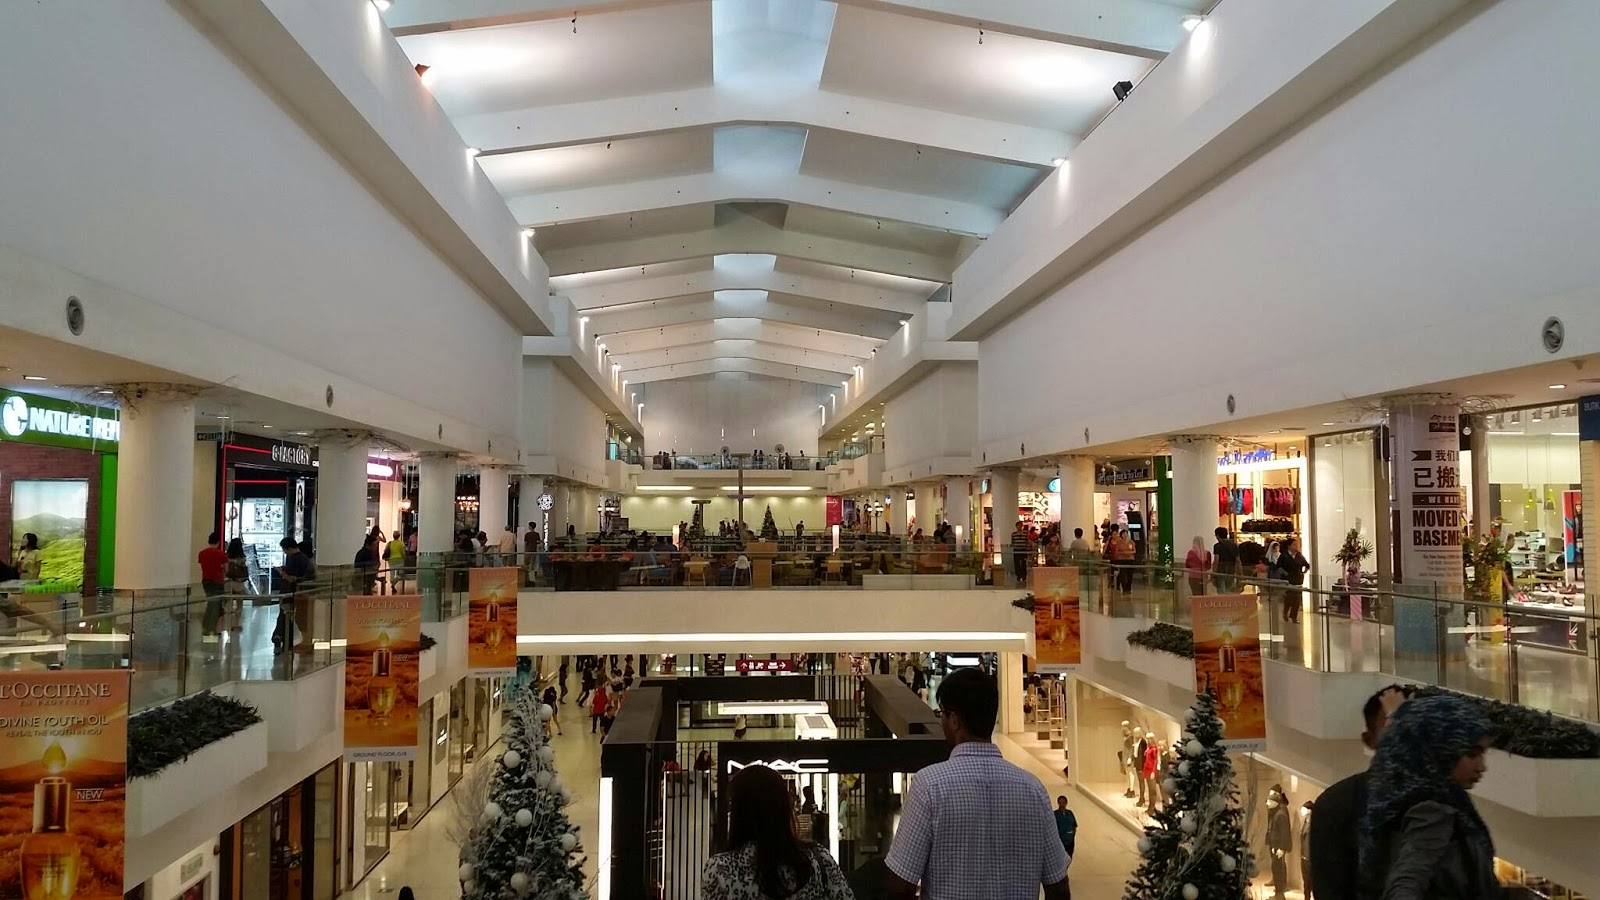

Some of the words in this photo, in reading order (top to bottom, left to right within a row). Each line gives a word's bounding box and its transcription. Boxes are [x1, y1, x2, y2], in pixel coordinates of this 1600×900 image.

[29, 407, 92, 437] NATURE
[92, 417, 120, 441] REP
[1435, 450, 1455, 461] 我们
[1413, 466, 1460, 488] 已搬
[1428, 496, 1441, 504] WE
[1413, 510, 1458, 527] MOVED
[0, 681, 112, 700] L'OCCITANE
[0, 717, 41, 728] DIVINE
[44, 715, 84, 727] YOUTH
[88, 714, 110, 726] OIL
[76, 790, 103, 800] NEW
